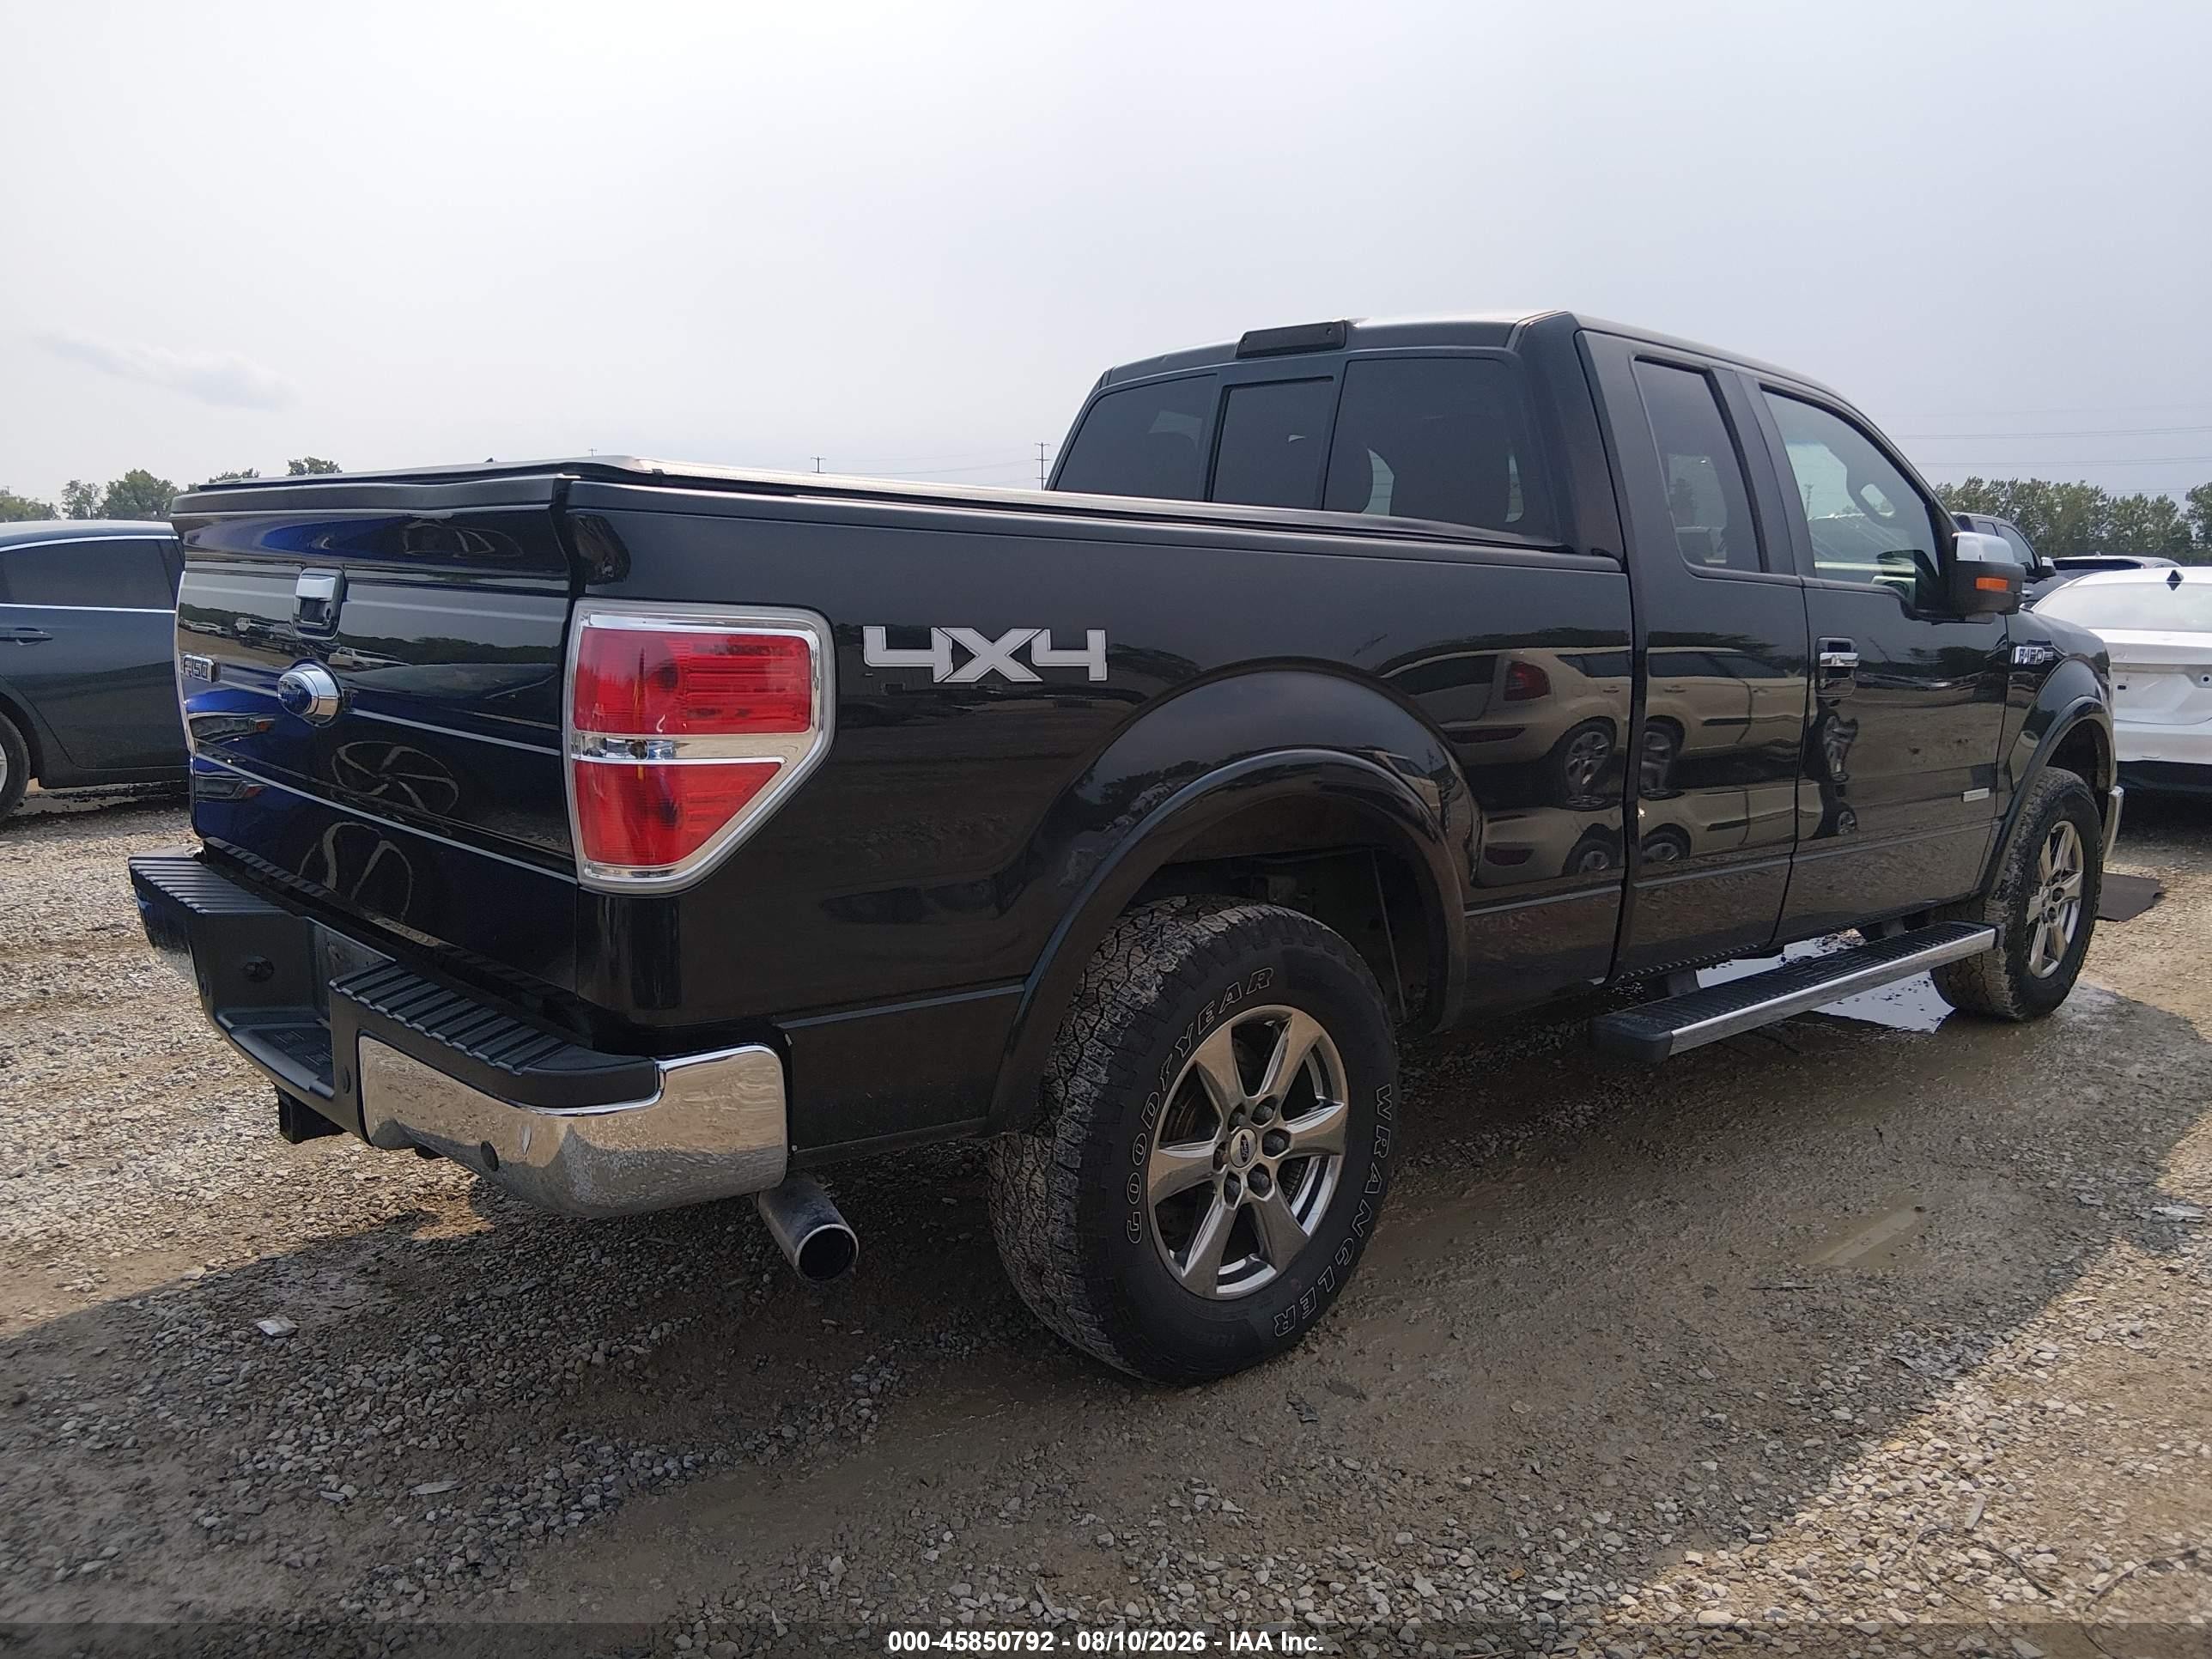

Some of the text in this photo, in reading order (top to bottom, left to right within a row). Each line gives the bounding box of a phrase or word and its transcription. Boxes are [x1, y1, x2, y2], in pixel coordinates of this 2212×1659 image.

[862, 625, 1108, 684] 4X4
[1126, 967, 1274, 1244] GOODYEAR
[1273, 1083, 1393, 1338] WRANGLER
